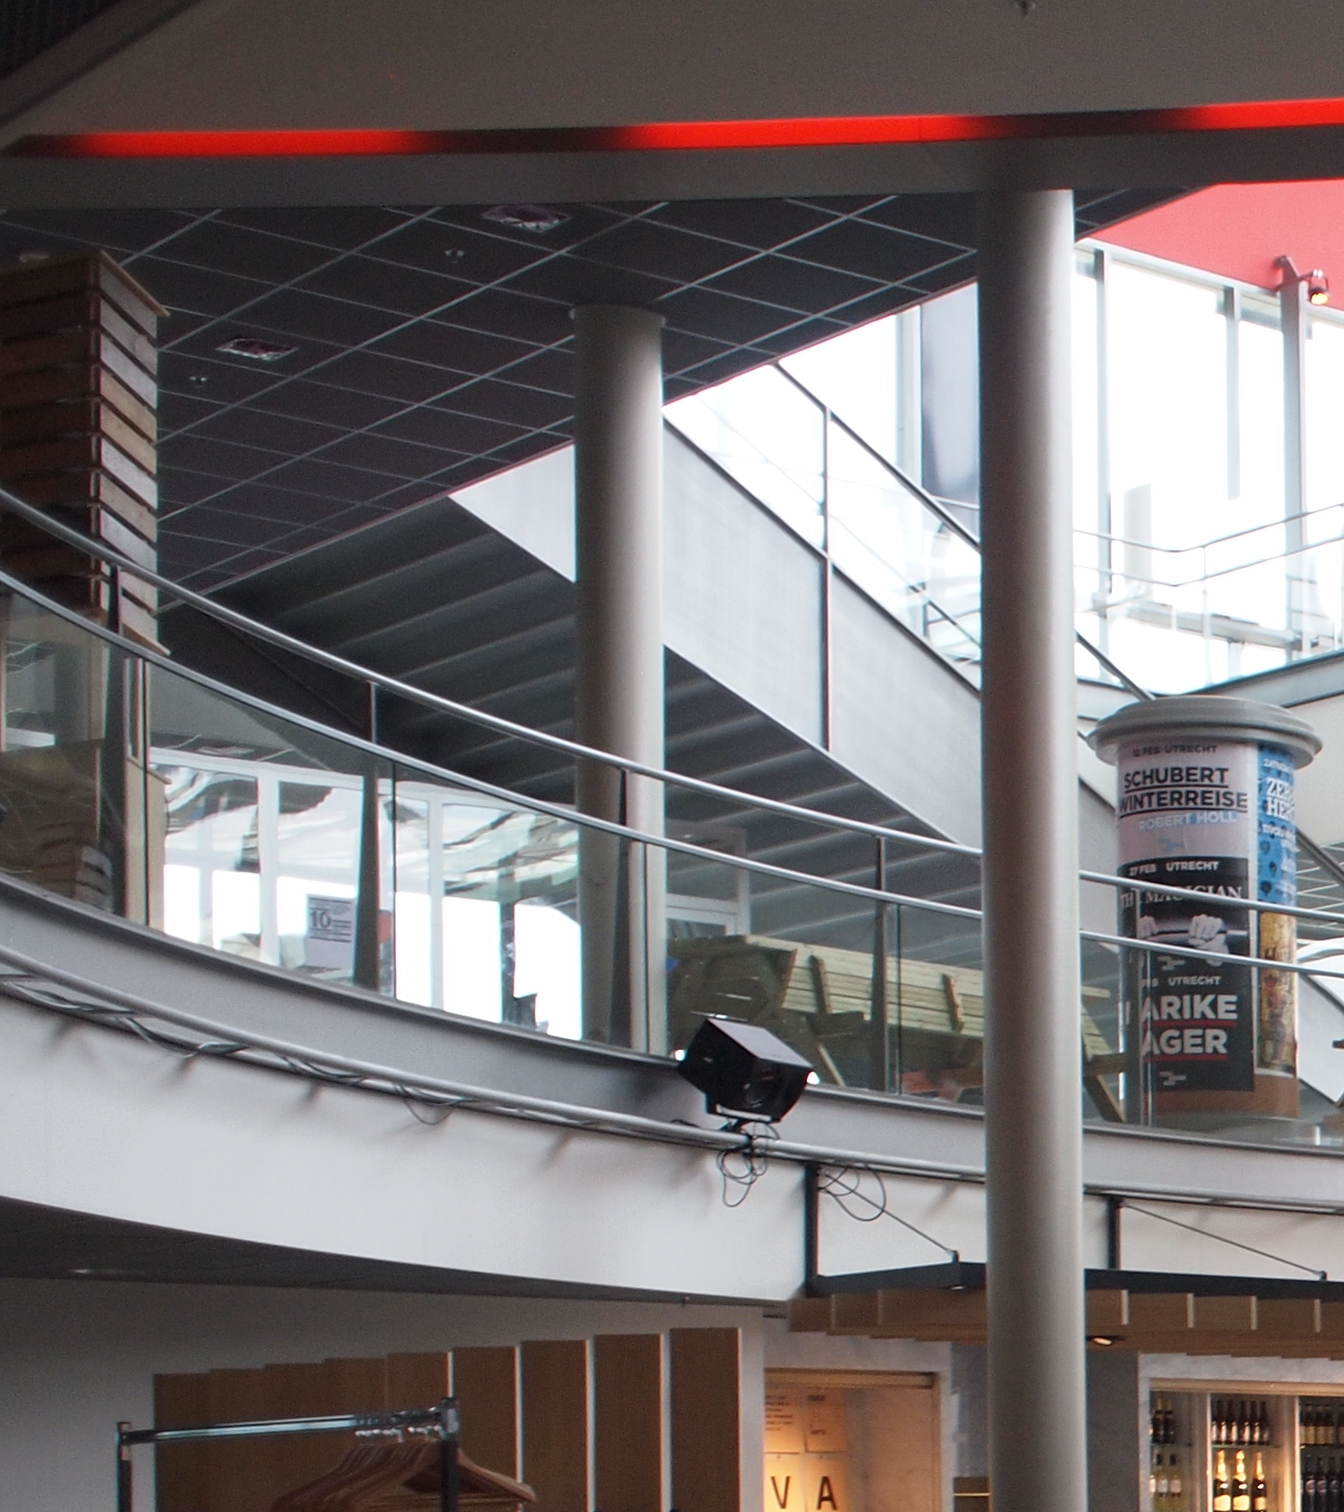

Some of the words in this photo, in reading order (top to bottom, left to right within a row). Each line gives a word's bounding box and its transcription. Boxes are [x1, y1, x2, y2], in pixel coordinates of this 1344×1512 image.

[1164, 745, 1217, 754] UTRECHT
[1124, 767, 1229, 789] SCHUBERT
[1120, 790, 1248, 812] WINTERREISE
[1196, 810, 1238, 823] HOLL
[1166, 861, 1219, 872] UTRECHT
[1168, 976, 1221, 986] UTRECHT
[1125, 994, 1238, 1024] ARIKE
[1139, 1029, 1228, 1056] AGER
